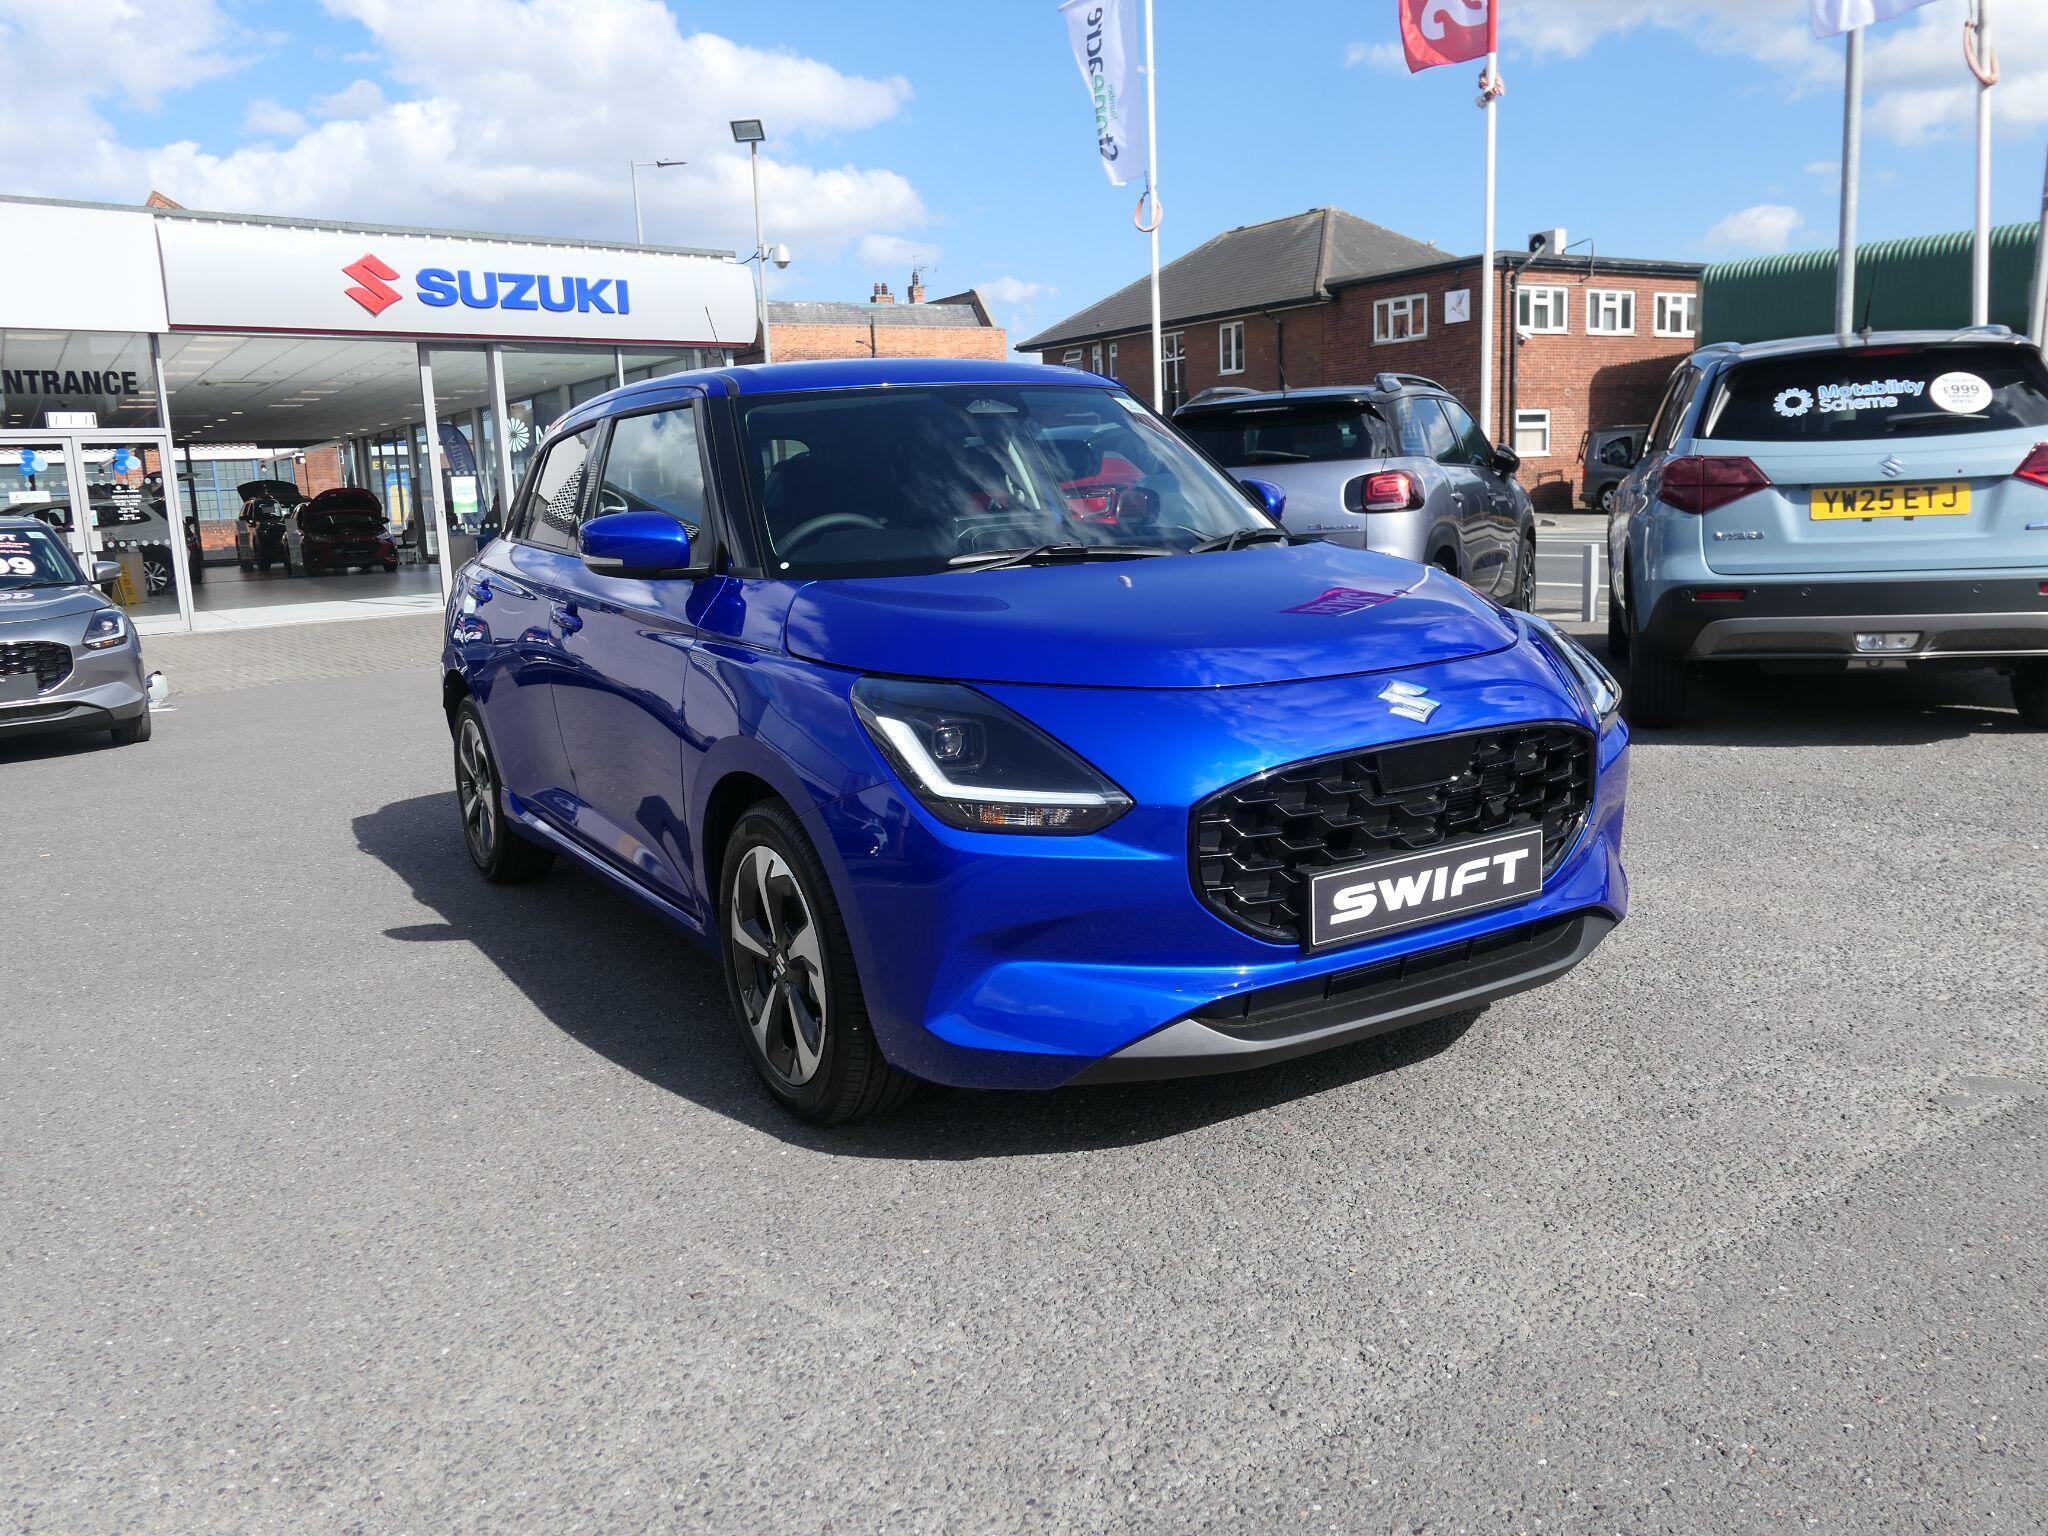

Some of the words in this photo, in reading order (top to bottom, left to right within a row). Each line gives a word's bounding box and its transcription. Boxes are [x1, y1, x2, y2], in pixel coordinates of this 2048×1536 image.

[415, 267, 630, 315] SUZUKI
[0, 369, 139, 395] NTRANCE
[1817, 379, 1925, 399] Motability
[1819, 395, 1899, 412] Scheme
[1822, 488, 1895, 513] YW25
[1903, 485, 1958, 510] ETJ
[1329, 848, 1529, 925] SWIFT
